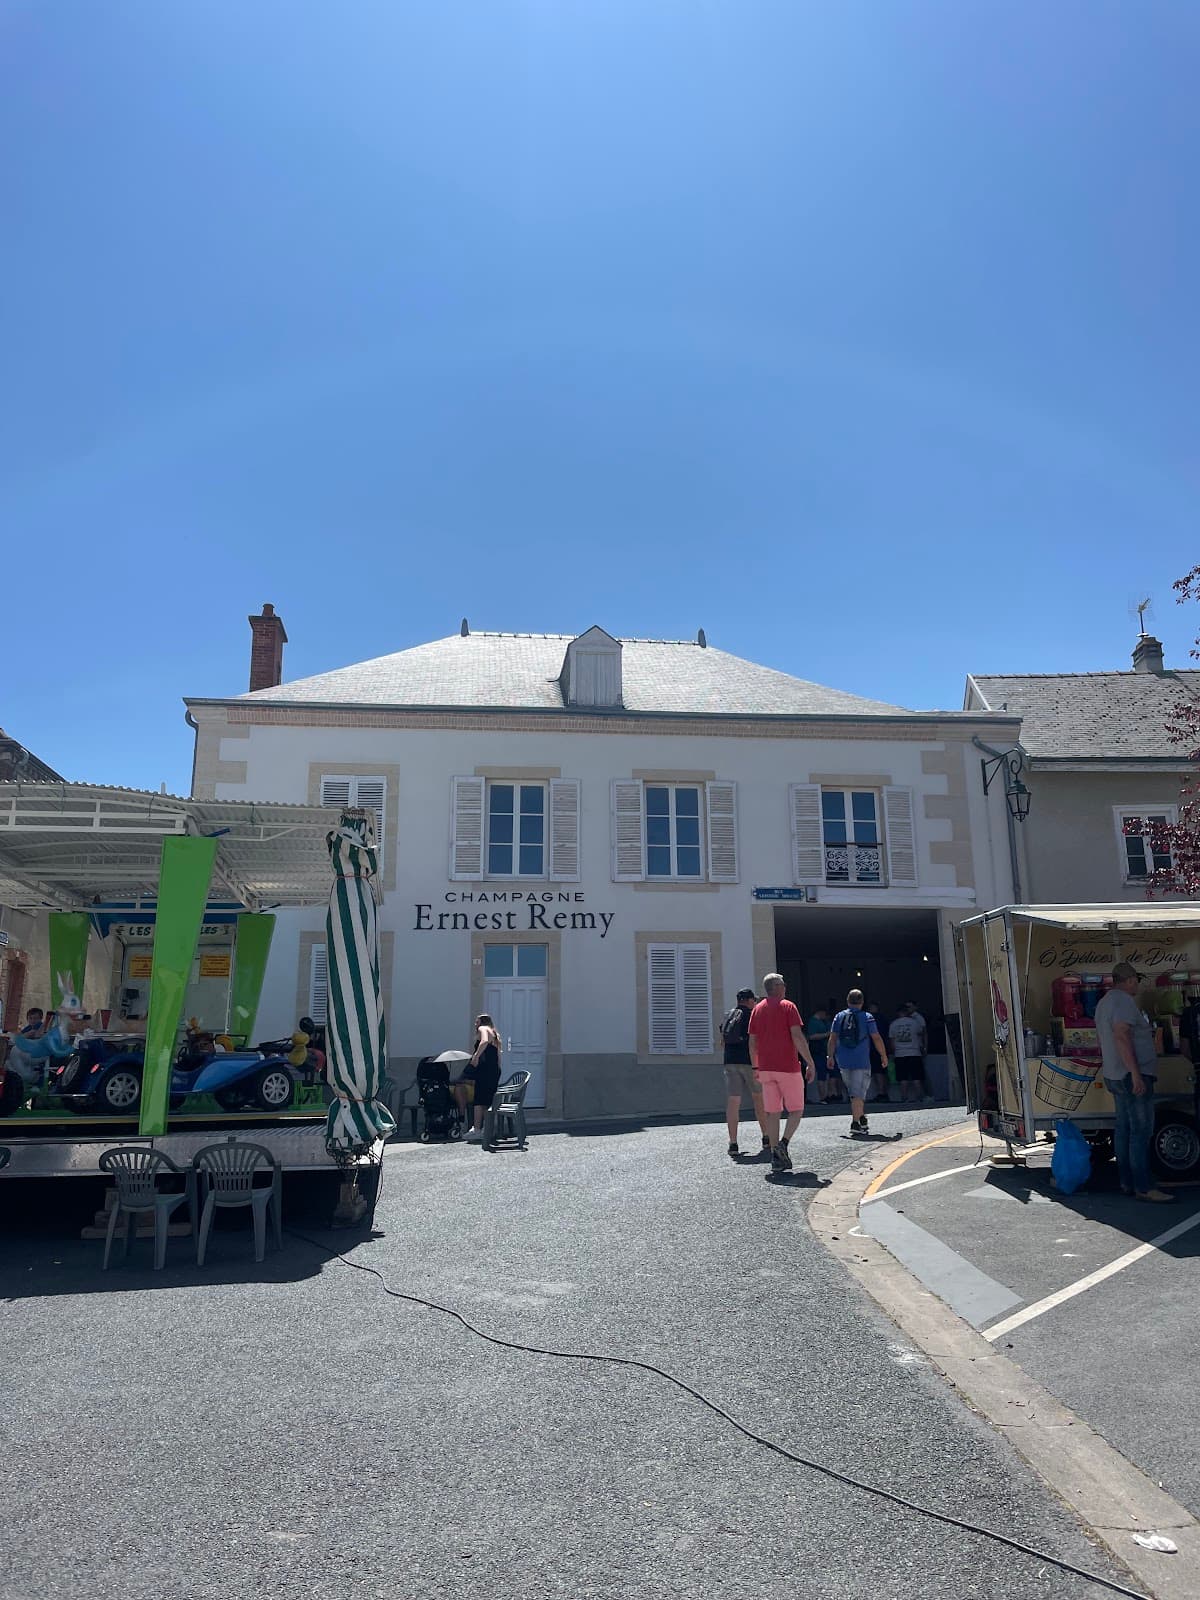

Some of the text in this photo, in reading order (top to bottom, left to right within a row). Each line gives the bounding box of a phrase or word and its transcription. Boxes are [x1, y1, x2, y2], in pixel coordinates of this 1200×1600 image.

[445, 892, 585, 902] CHAMPAGNE
[413, 903, 615, 938] Ernest Remy
[128, 926, 152, 936] LES
[1126, 949, 1143, 963] de
[1145, 948, 1188, 968] Days
